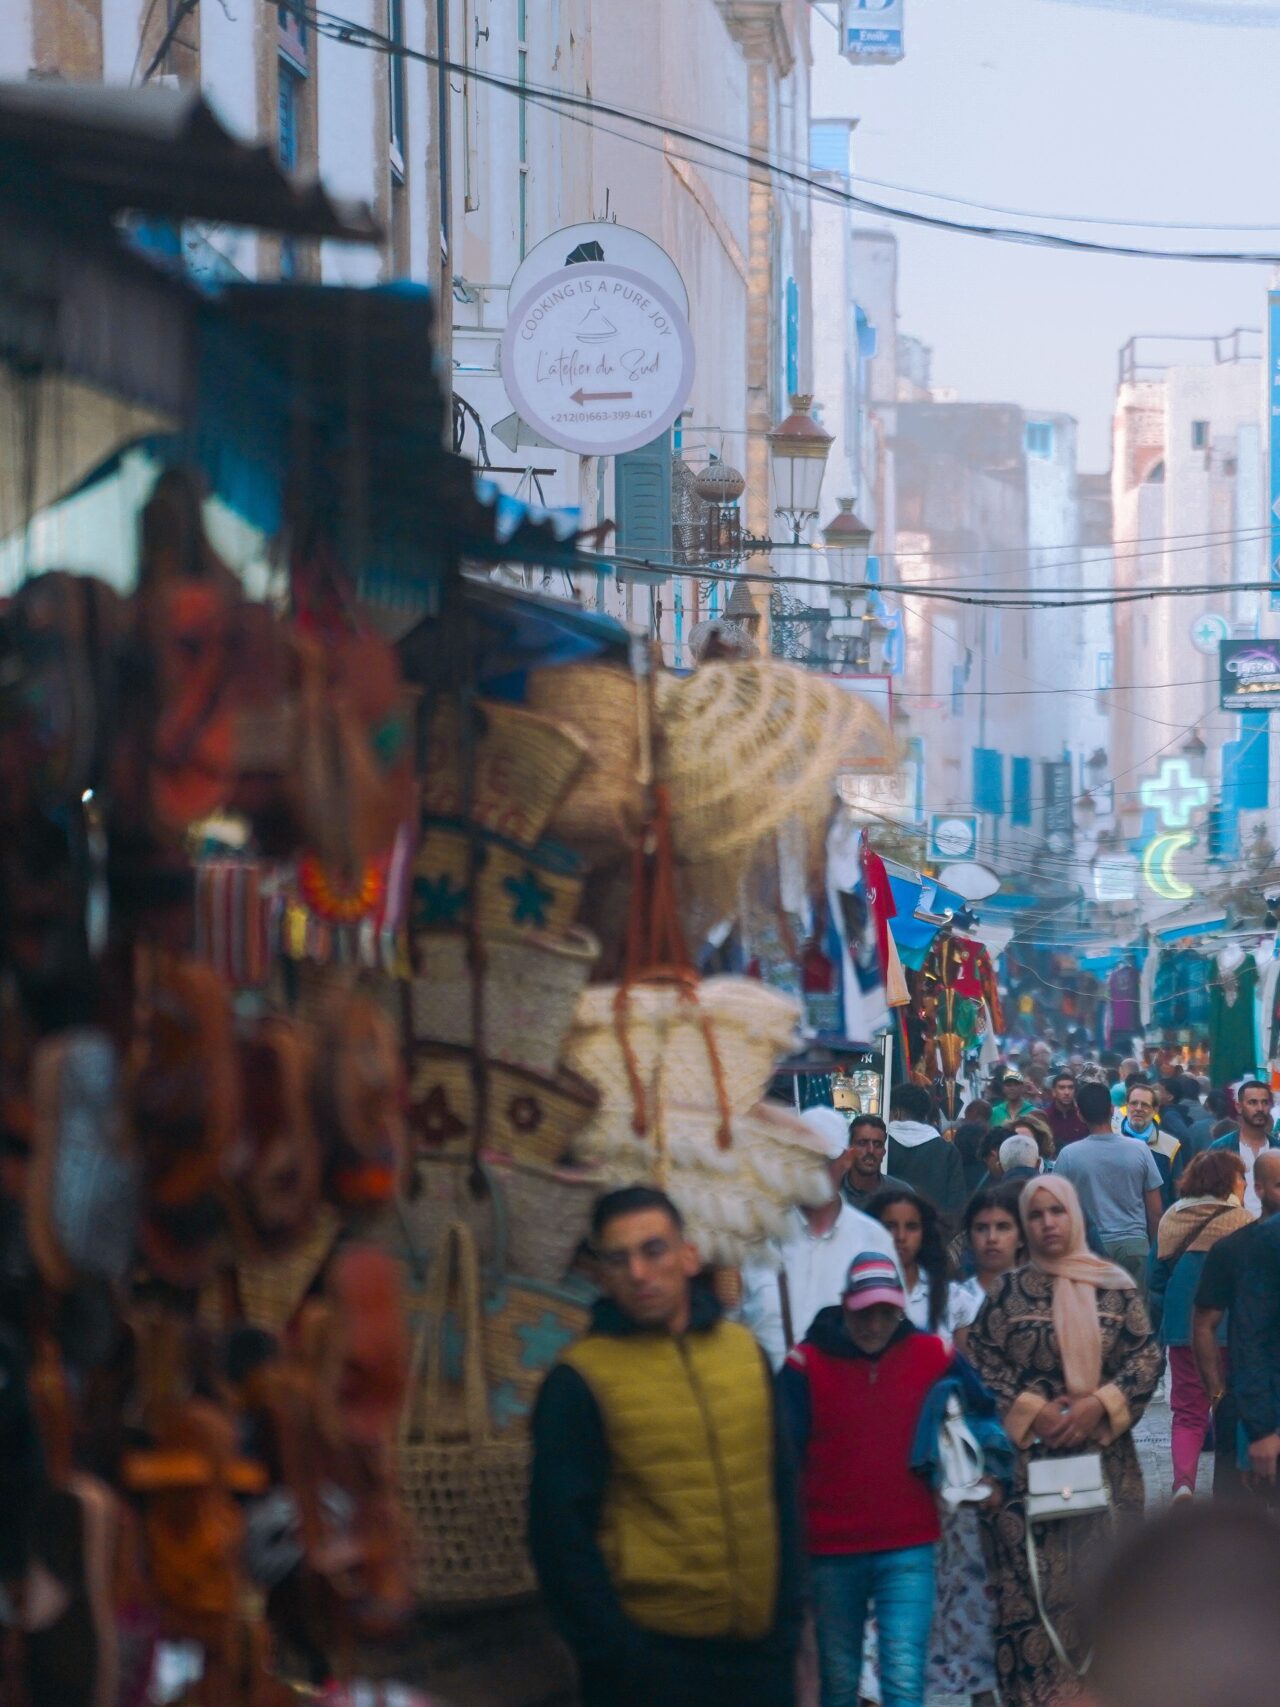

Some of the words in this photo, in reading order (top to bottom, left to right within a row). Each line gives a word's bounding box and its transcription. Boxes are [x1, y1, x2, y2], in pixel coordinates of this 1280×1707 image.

[521, 284, 575, 341] COOKING
[579, 280, 593, 293] IS
[598, 280, 607, 292] A
[613, 283, 651, 312] PURE
[648, 311, 672, 336] JOY
[595, 353, 614, 376] du
[619, 349, 660, 382] Sud
